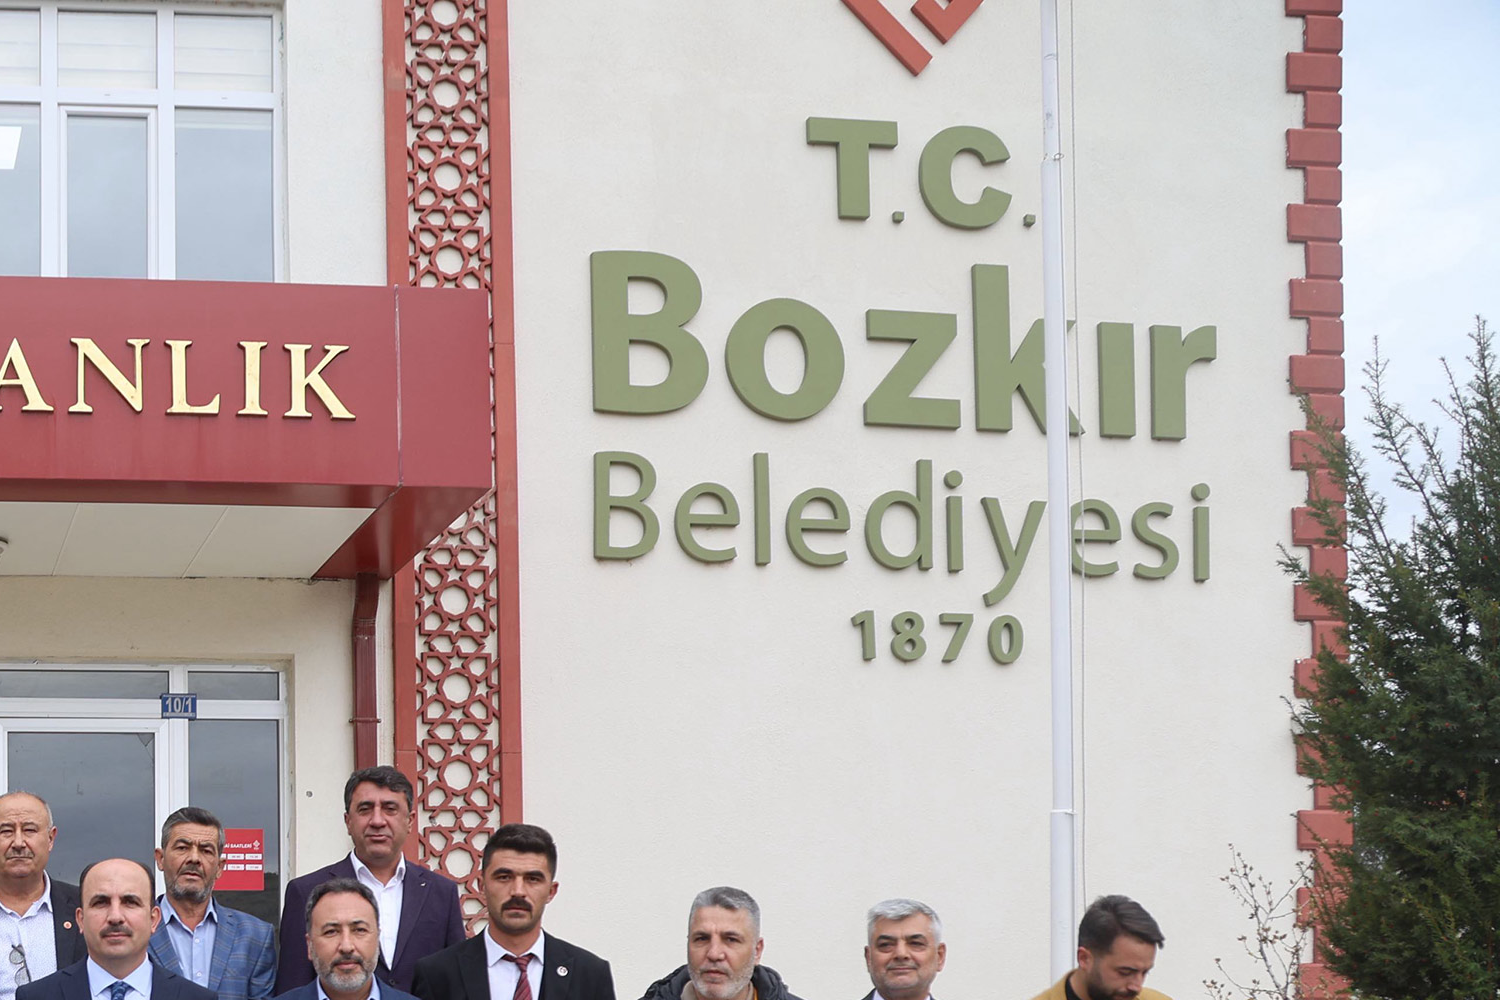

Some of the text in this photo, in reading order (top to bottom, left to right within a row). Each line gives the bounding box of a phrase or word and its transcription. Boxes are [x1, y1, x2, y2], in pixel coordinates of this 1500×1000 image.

[806, 116, 1037, 230] T.C.
[590, 250, 1218, 442] Bozkır
[593, 450, 1211, 608] Belediyesi
[851, 610, 1024, 665] 1870
[165, 697, 192, 713] 10/1
